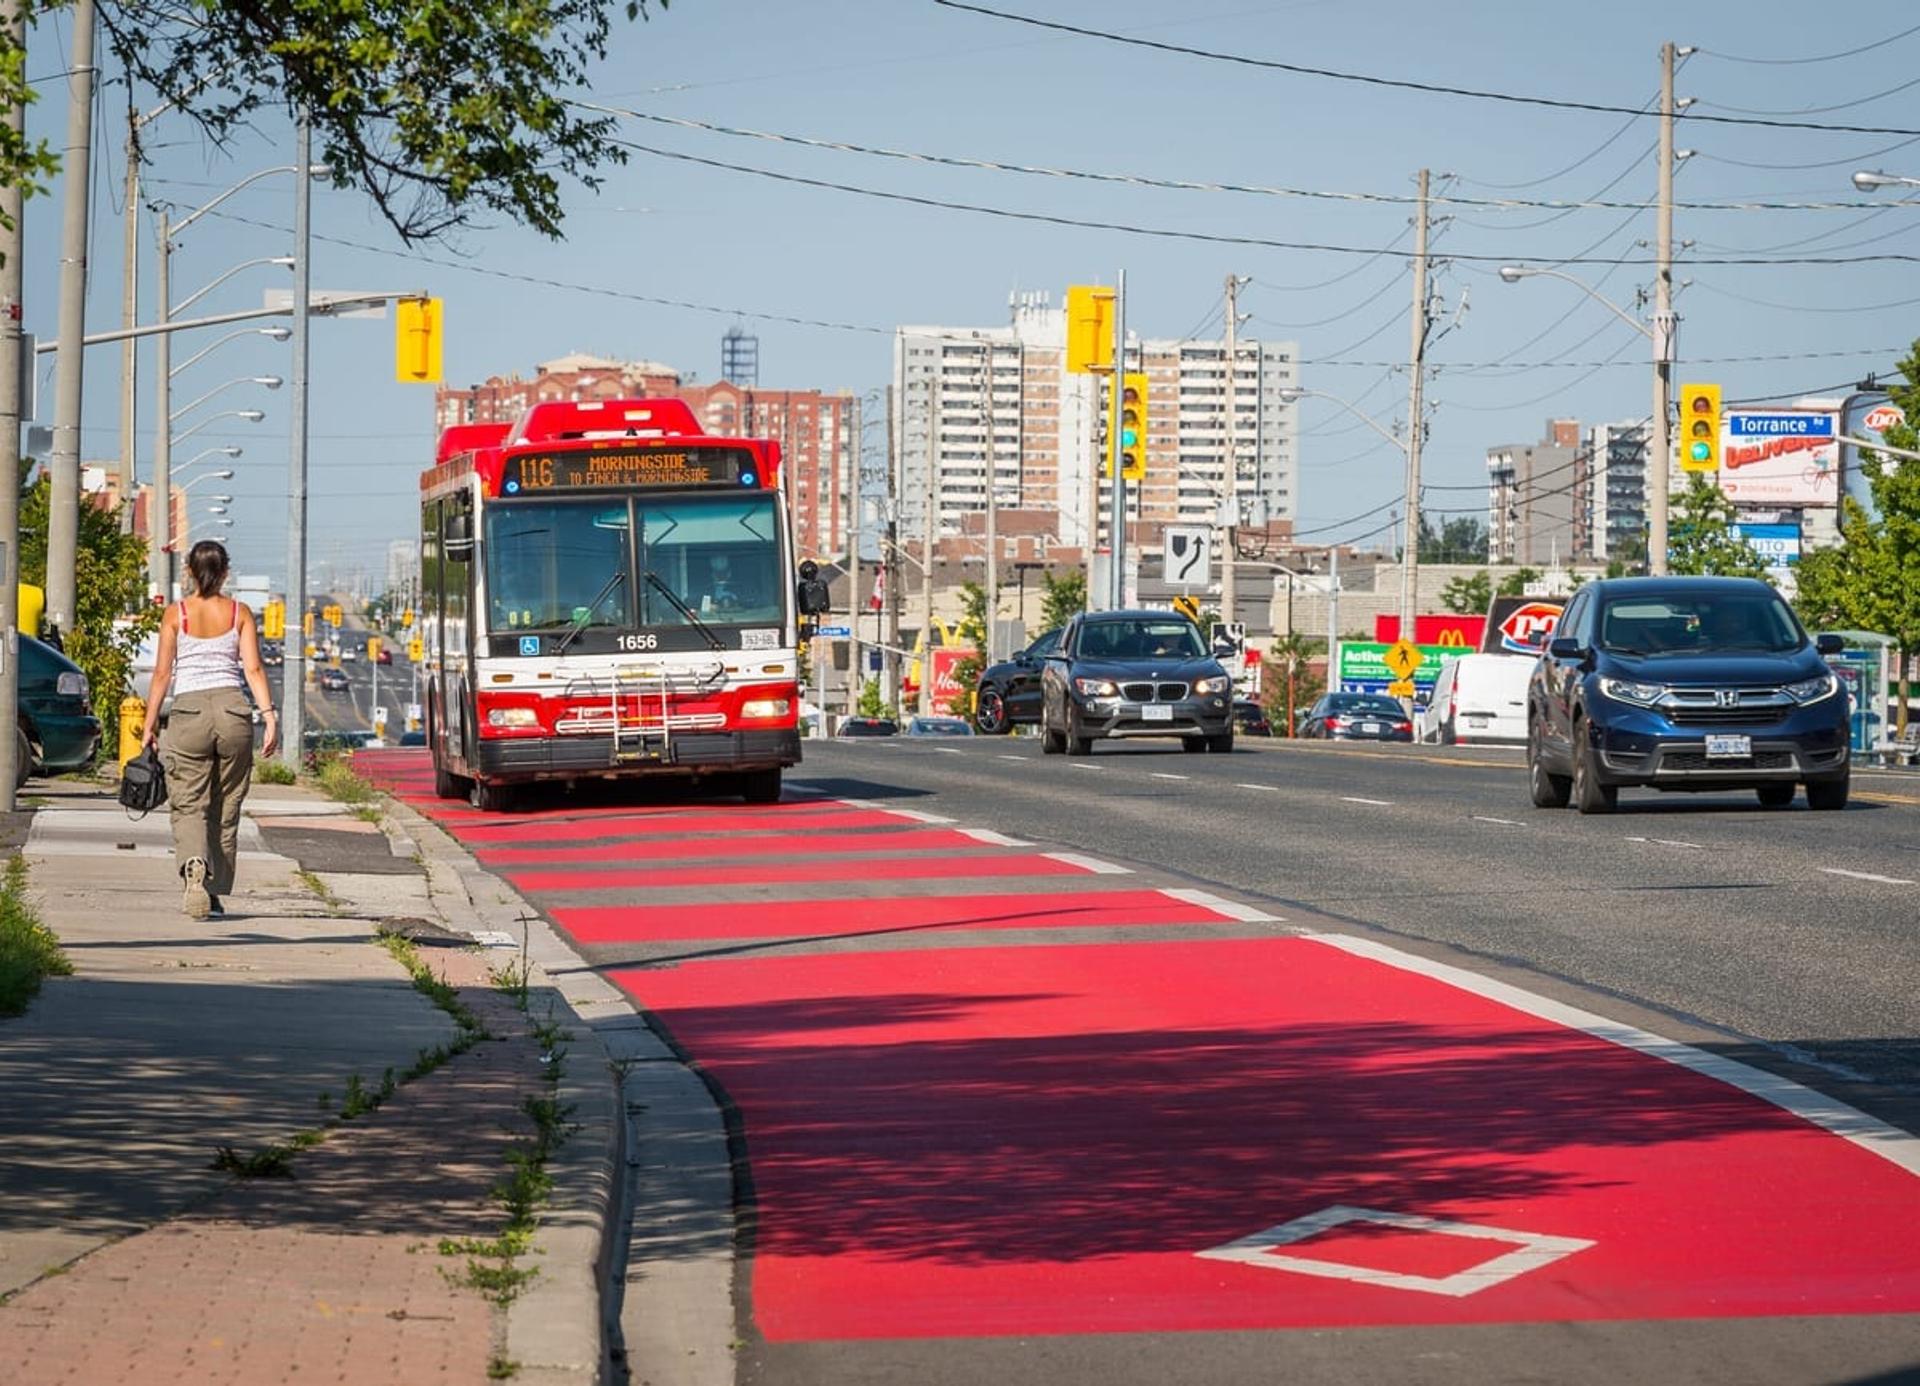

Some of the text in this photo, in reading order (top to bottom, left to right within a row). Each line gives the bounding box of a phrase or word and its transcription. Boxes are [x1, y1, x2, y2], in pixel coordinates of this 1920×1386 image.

[1740, 417, 1825, 433] Torrance Rd
[519, 454, 688, 488] 116 MORNINGSIDE
[570, 472, 580, 486] TO
[586, 471, 619, 485] FINCH
[636, 467, 710, 484] MORNINGSIDE
[616, 634, 658, 650] 1656
